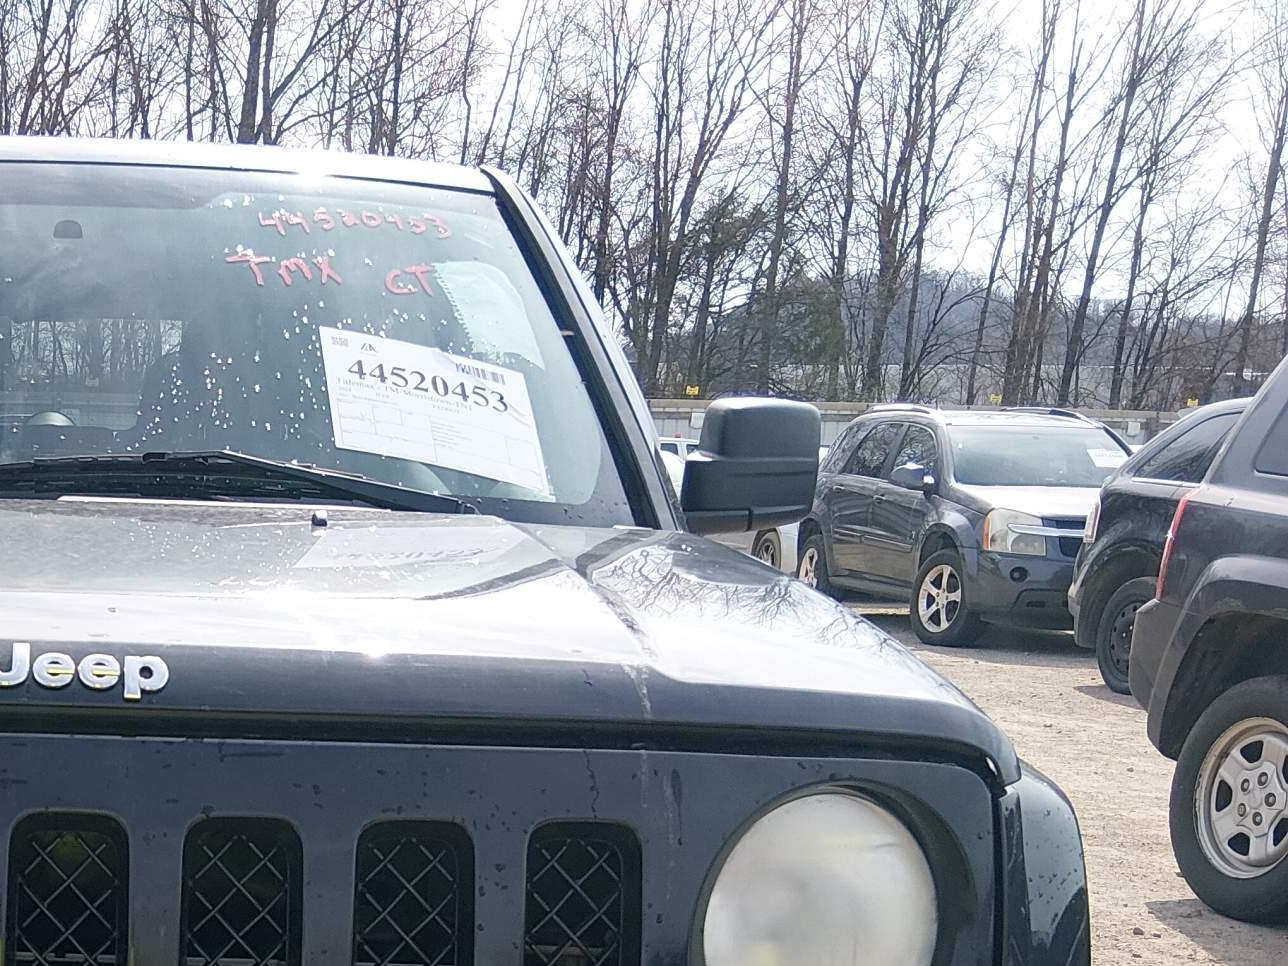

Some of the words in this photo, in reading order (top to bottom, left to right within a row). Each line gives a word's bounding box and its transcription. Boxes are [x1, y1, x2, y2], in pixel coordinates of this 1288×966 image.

[225, 253, 344, 287] TMX
[384, 263, 435, 298] CT
[346, 359, 509, 413] 44520453
